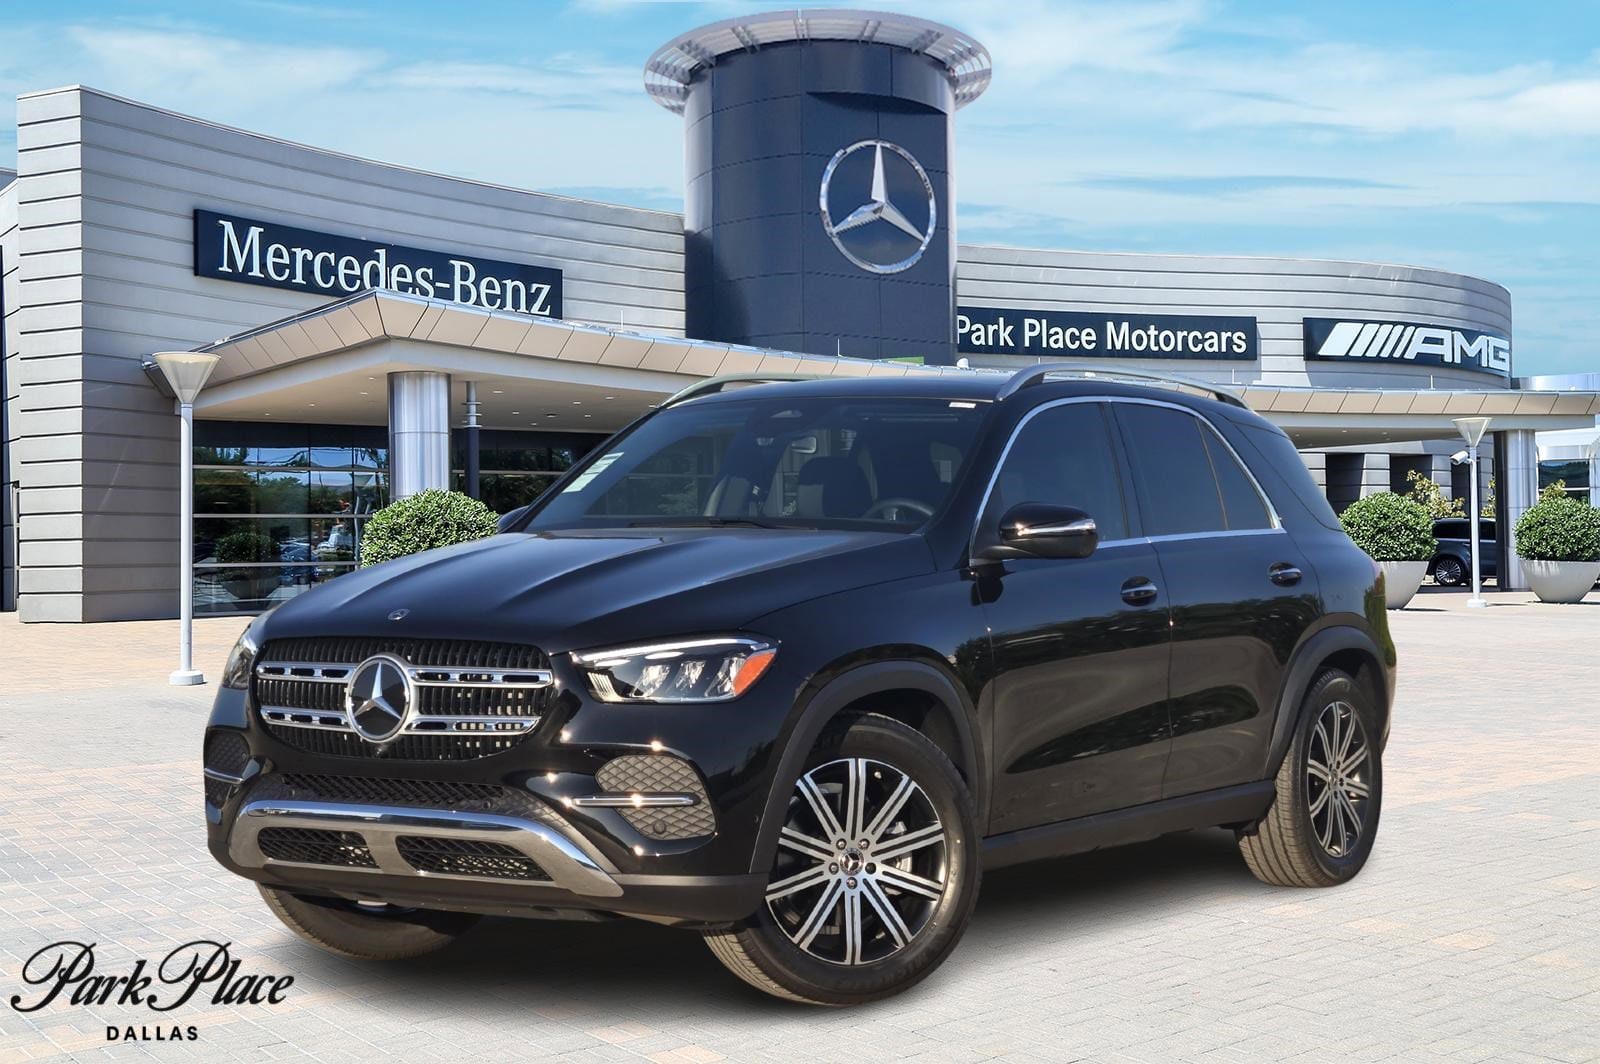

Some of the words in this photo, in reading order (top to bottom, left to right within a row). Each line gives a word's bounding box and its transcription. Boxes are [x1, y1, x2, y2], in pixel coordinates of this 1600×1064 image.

[218, 220, 552, 316] Mercedes-Benz
[957, 315, 1014, 347] Park
[1023, 318, 1097, 350] Place
[1106, 320, 1247, 353] Motorcars
